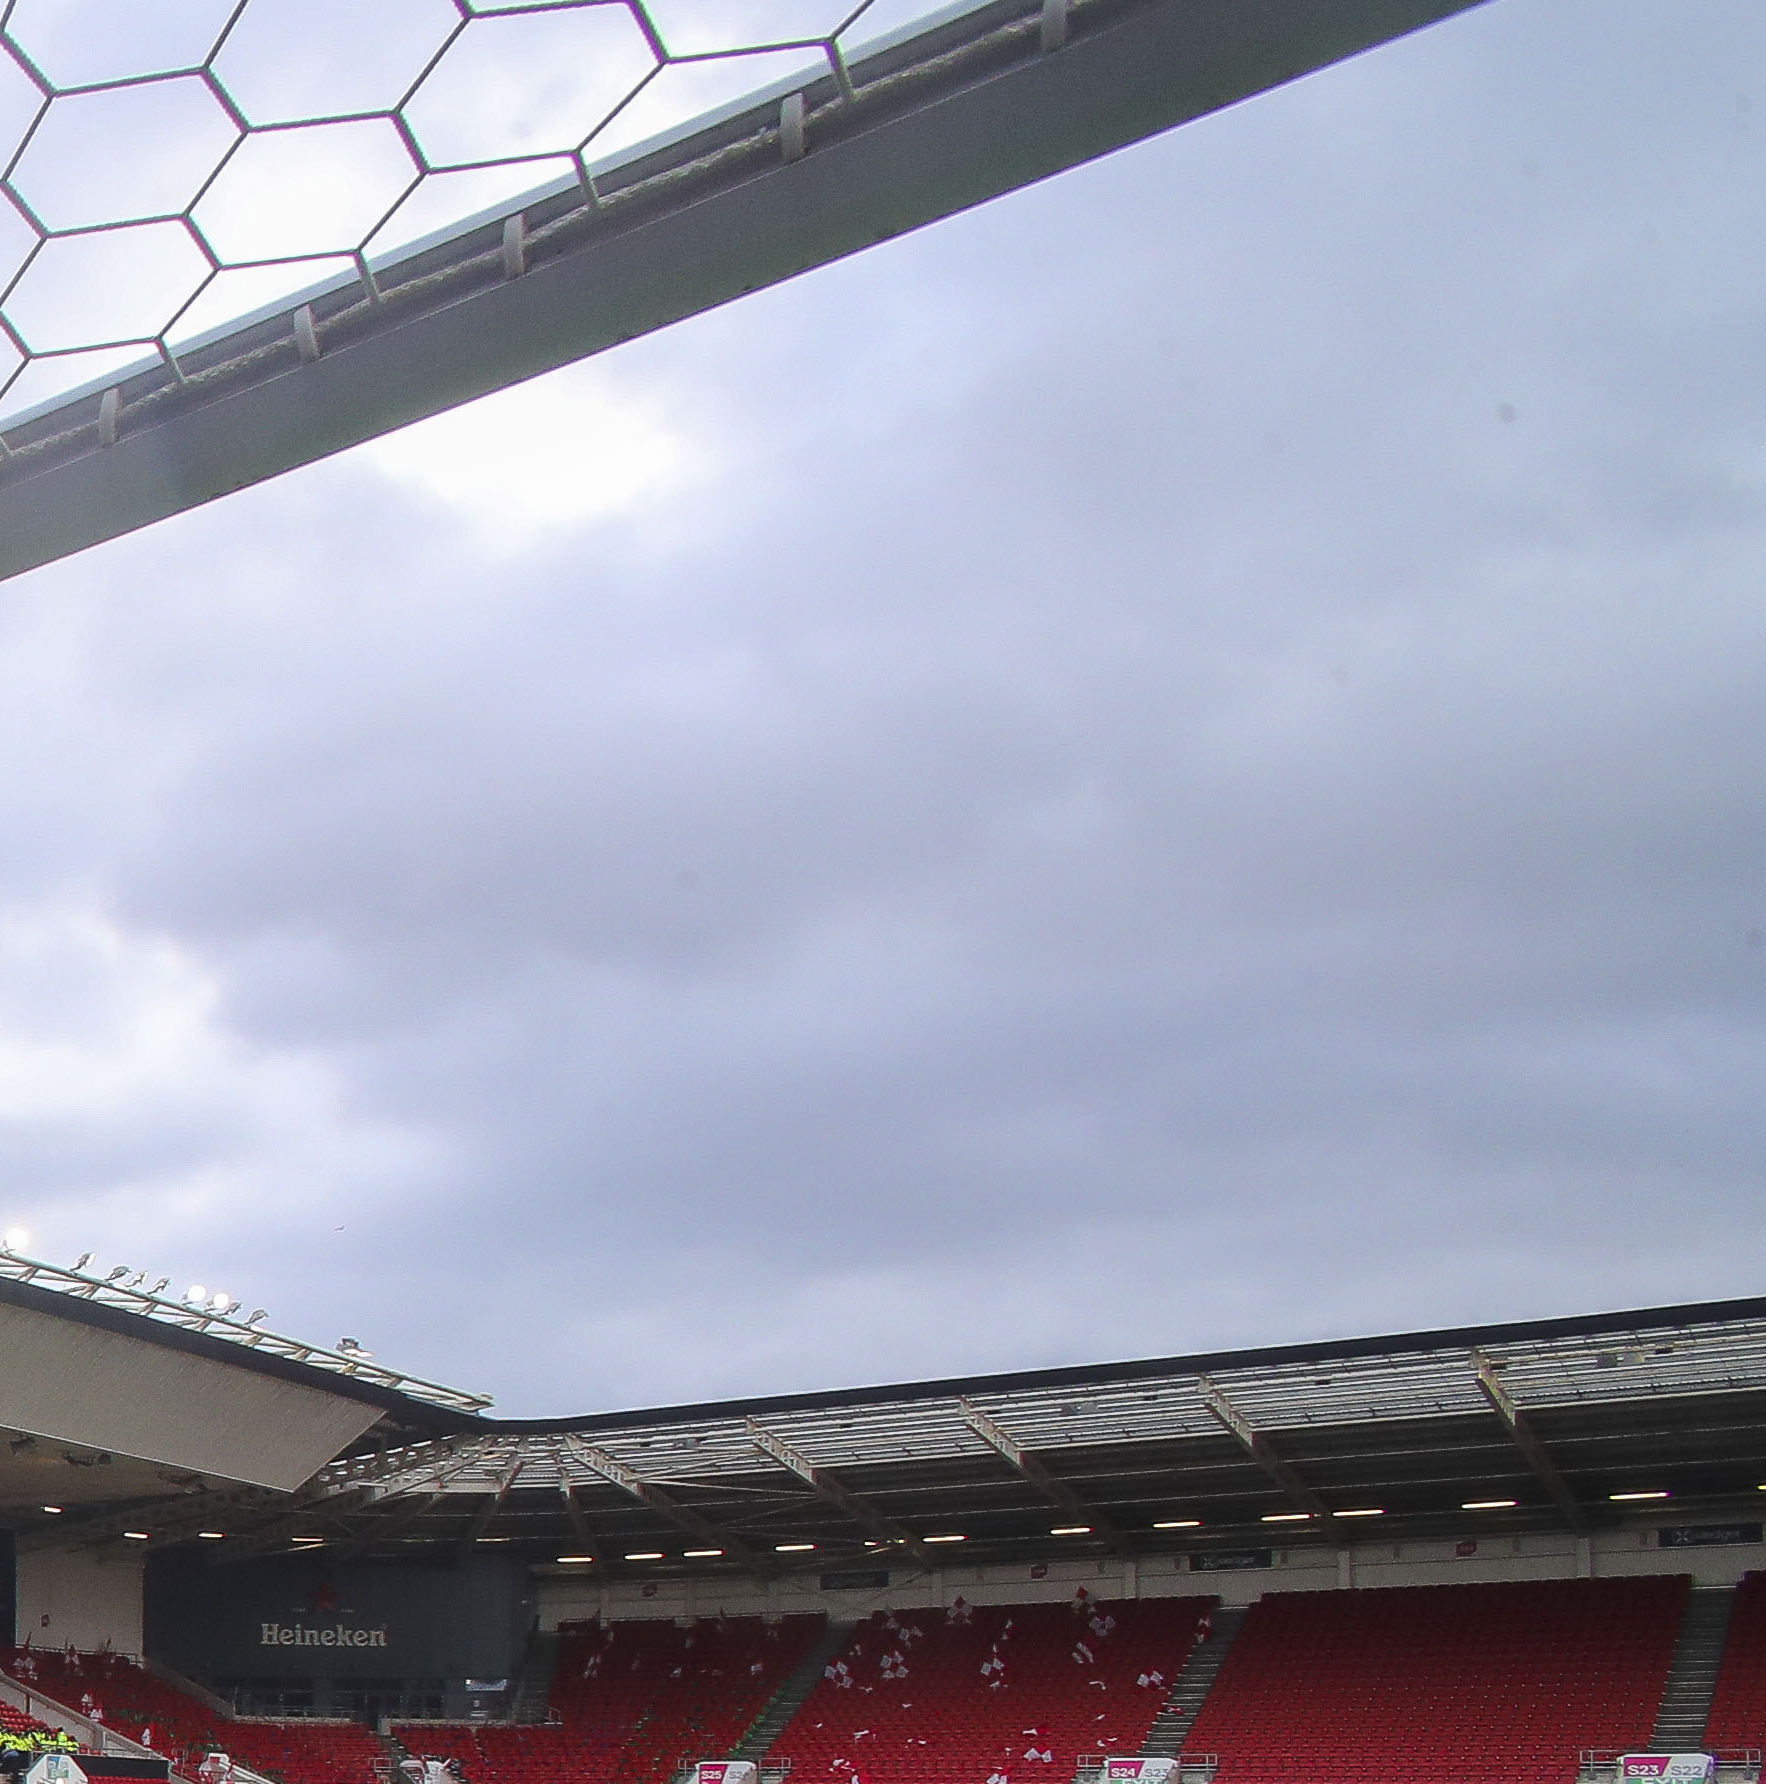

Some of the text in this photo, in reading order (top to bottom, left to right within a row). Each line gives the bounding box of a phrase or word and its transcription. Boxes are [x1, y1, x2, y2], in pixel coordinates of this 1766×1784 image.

[261, 1623, 387, 1647] Heineken
[701, 1771, 722, 1779] S25
[1111, 1768, 1136, 1777] S24
[1627, 1765, 1702, 1776] S23 S22
